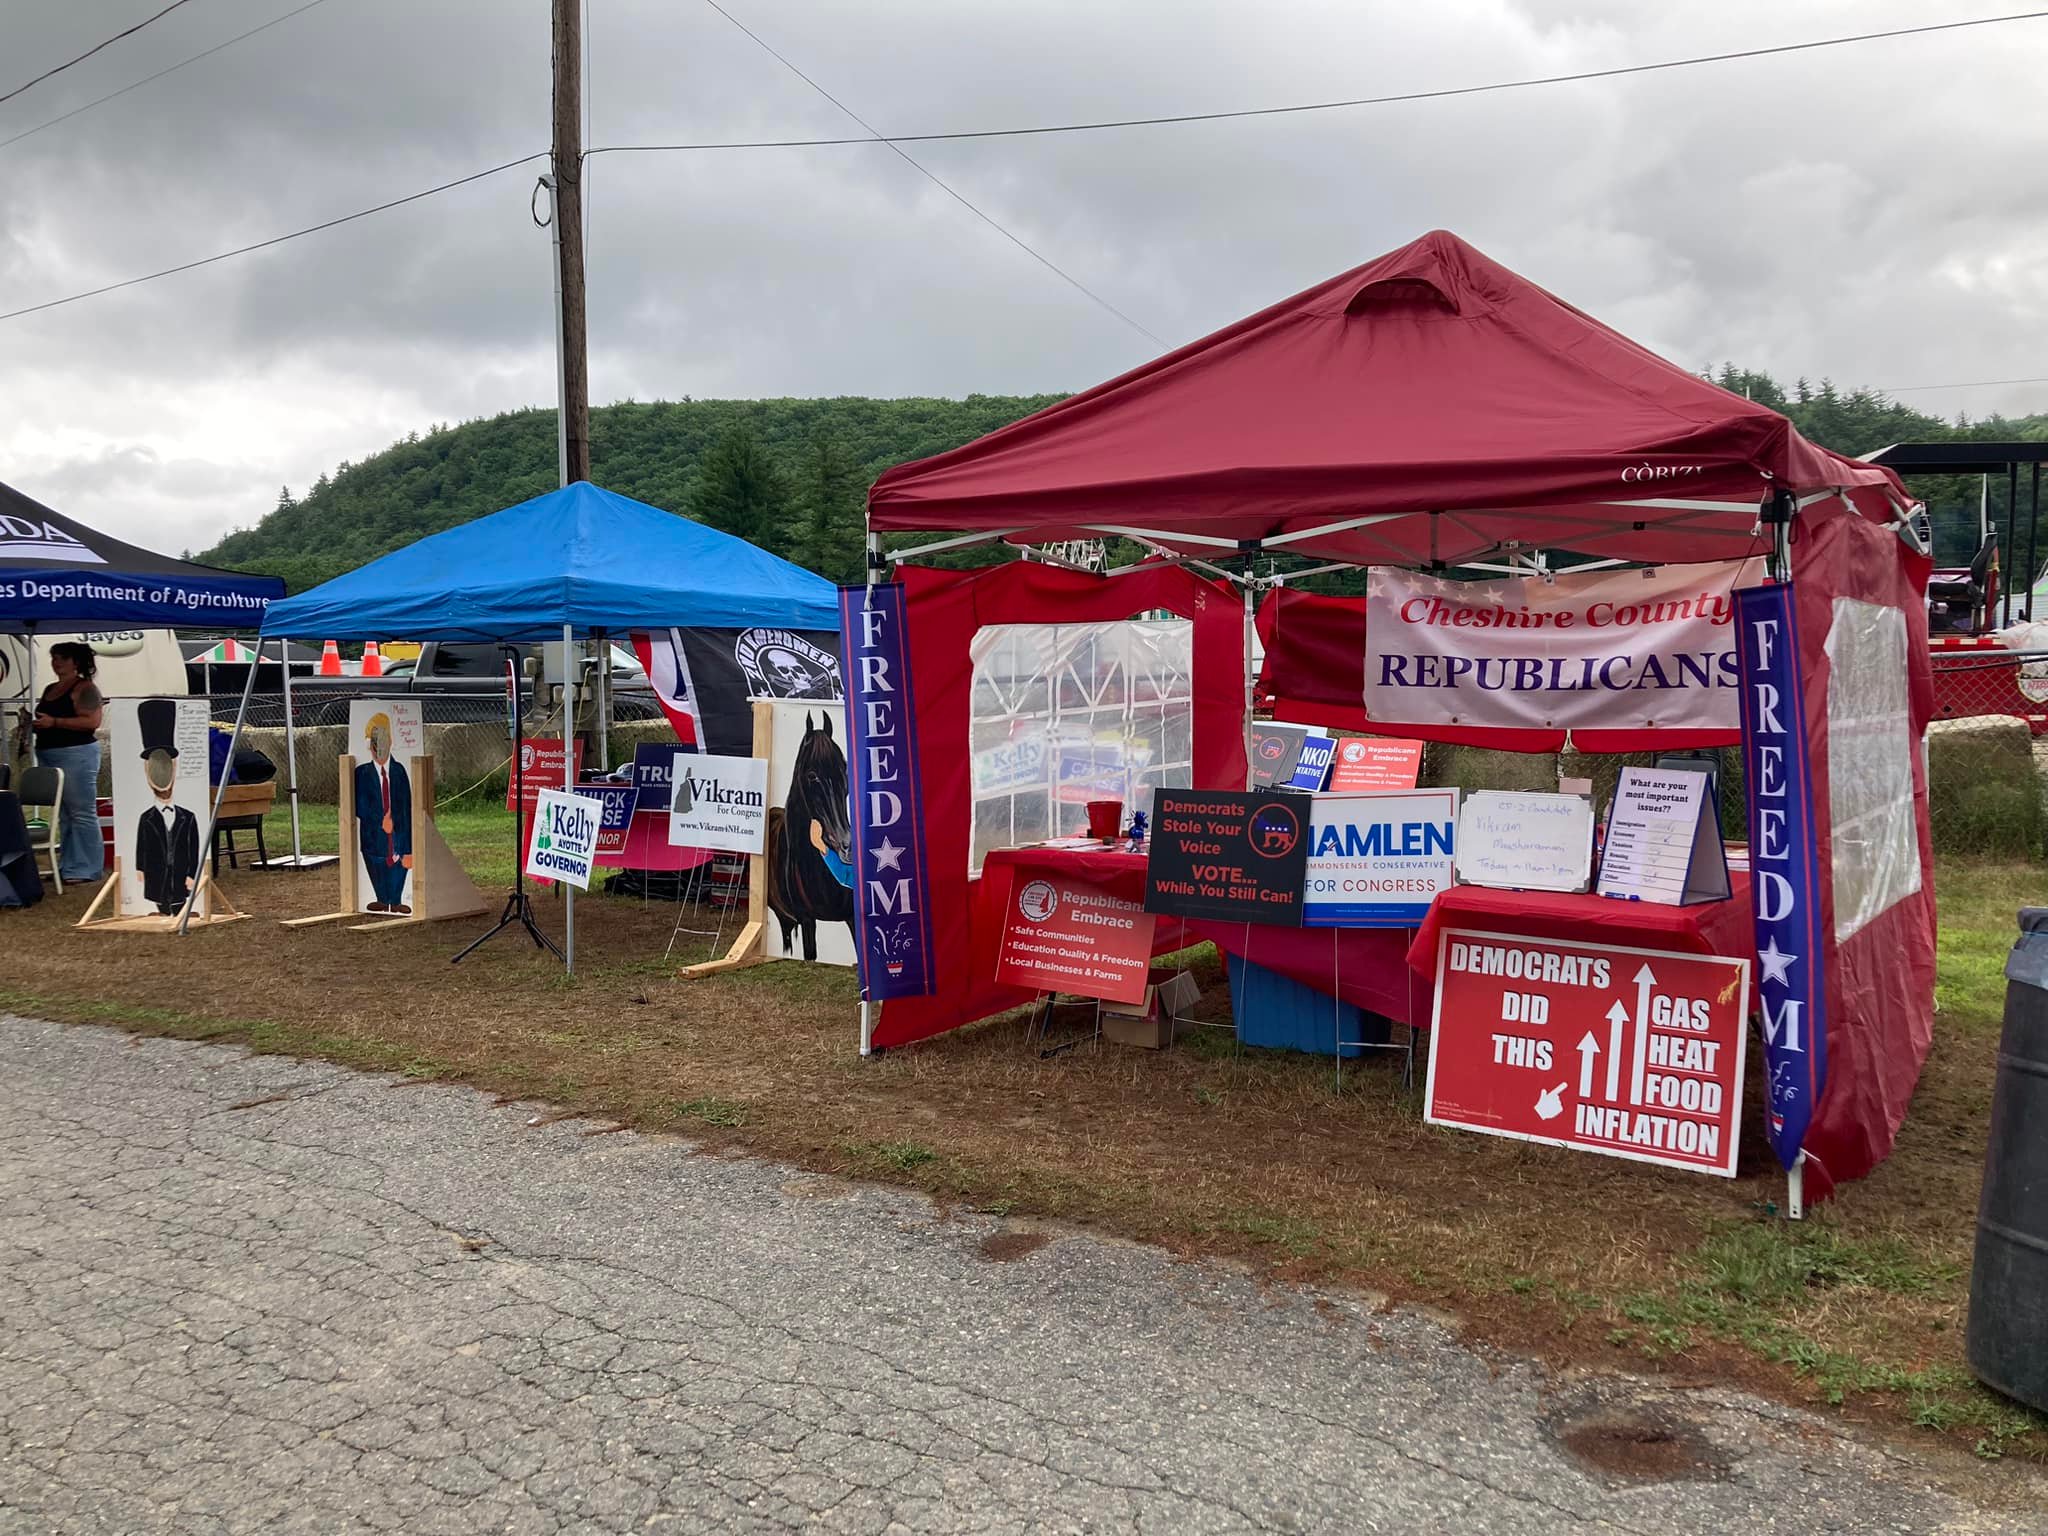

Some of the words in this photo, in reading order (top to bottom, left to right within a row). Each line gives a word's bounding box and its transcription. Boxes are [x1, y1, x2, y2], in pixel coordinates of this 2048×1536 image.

[22, 580, 145, 602] Department
[150, 587, 171, 603] of
[174, 588, 271, 609] Agriculture
[1400, 596, 1574, 629] Cheshire
[1586, 592, 1734, 627] County
[77, 631, 144, 643] Jayco
[1377, 650, 1740, 691] REPUBLICANS
[1300, 747, 1329, 767] NKO
[1368, 746, 1417, 754] Republicans
[640, 766, 672, 782] TRU
[1295, 766, 1323, 778] NTATIVE
[687, 778, 763, 807] Vikram
[1630, 778, 1651, 788] What
[1668, 782, 1688, 791] your
[1163, 799, 1246, 816] Democrats
[1625, 791, 1645, 799] most
[1646, 792, 1689, 803] important
[717, 805, 729, 815] For
[731, 806, 762, 820] Congress
[1637, 803, 1672, 813] issues??
[553, 805, 594, 852] Kelly
[1163, 819, 1202, 834] Stole
[1207, 822, 1242, 836] Your
[558, 838, 582, 853] AYOTTE
[1180, 839, 1222, 855] Voice
[1308, 821, 1453, 857] AMLEN
[536, 852, 587, 878] GOVERNOR
[1192, 864, 1257, 885] VOTE...
[1306, 862, 1369, 870] MMONSENSE
[1373, 860, 1445, 869] CONSERVATIVE
[1156, 880, 1195, 895] While
[1199, 885, 1225, 898] You
[1228, 886, 1256, 901] Still
[1260, 890, 1293, 904] Can!
[1305, 879, 1336, 892] FOR
[1343, 878, 1436, 892] CONGRESS
[1071, 910, 1134, 929] Embrace
[1015, 926, 1034, 936] Safe
[1036, 928, 1095, 945] Communities
[1012, 941, 1056, 955] Education
[1058, 946, 1091, 961] Quality
[1093, 953, 1099, 961] &
[1101, 954, 1144, 969] Freedom
[1450, 942, 1612, 989] DEMOCRATS
[1010, 957, 1033, 968] Local
[1035, 960, 1083, 976] Businesses
[1085, 967, 1091, 976] &
[1093, 969, 1123, 982] Farms
[1501, 991, 1550, 1025] DID
[1652, 995, 1710, 1031] GAS
[1491, 1033, 1553, 1072] THIS
[1648, 1033, 1721, 1073] HEAT
[1646, 1072, 1723, 1115] FOOD
[1575, 1103, 1720, 1158] INFLATION
